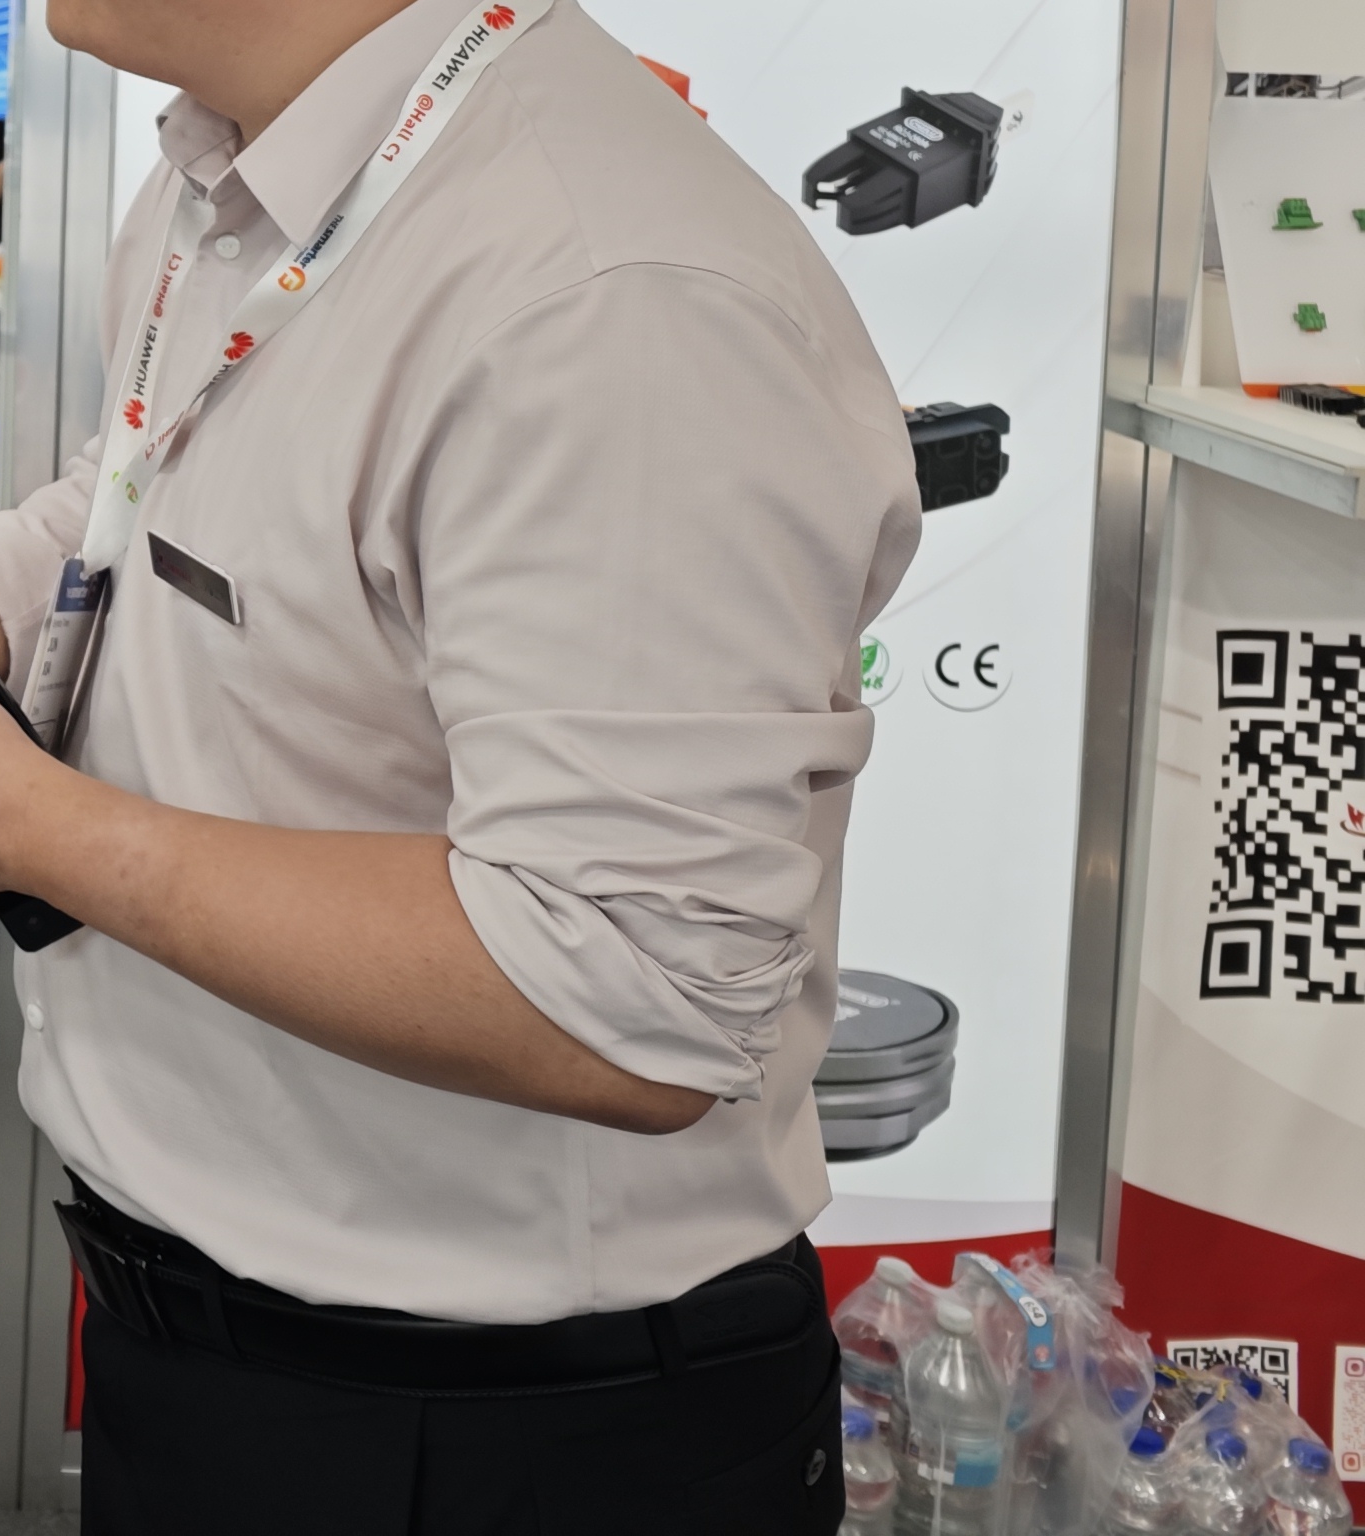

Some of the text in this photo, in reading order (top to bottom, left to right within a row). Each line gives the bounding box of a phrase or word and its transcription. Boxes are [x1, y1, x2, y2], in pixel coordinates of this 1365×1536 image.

[380, 24, 491, 163] HUAWEI @Hall C1
[133, 252, 184, 396] HUAWEI @Hall C1
